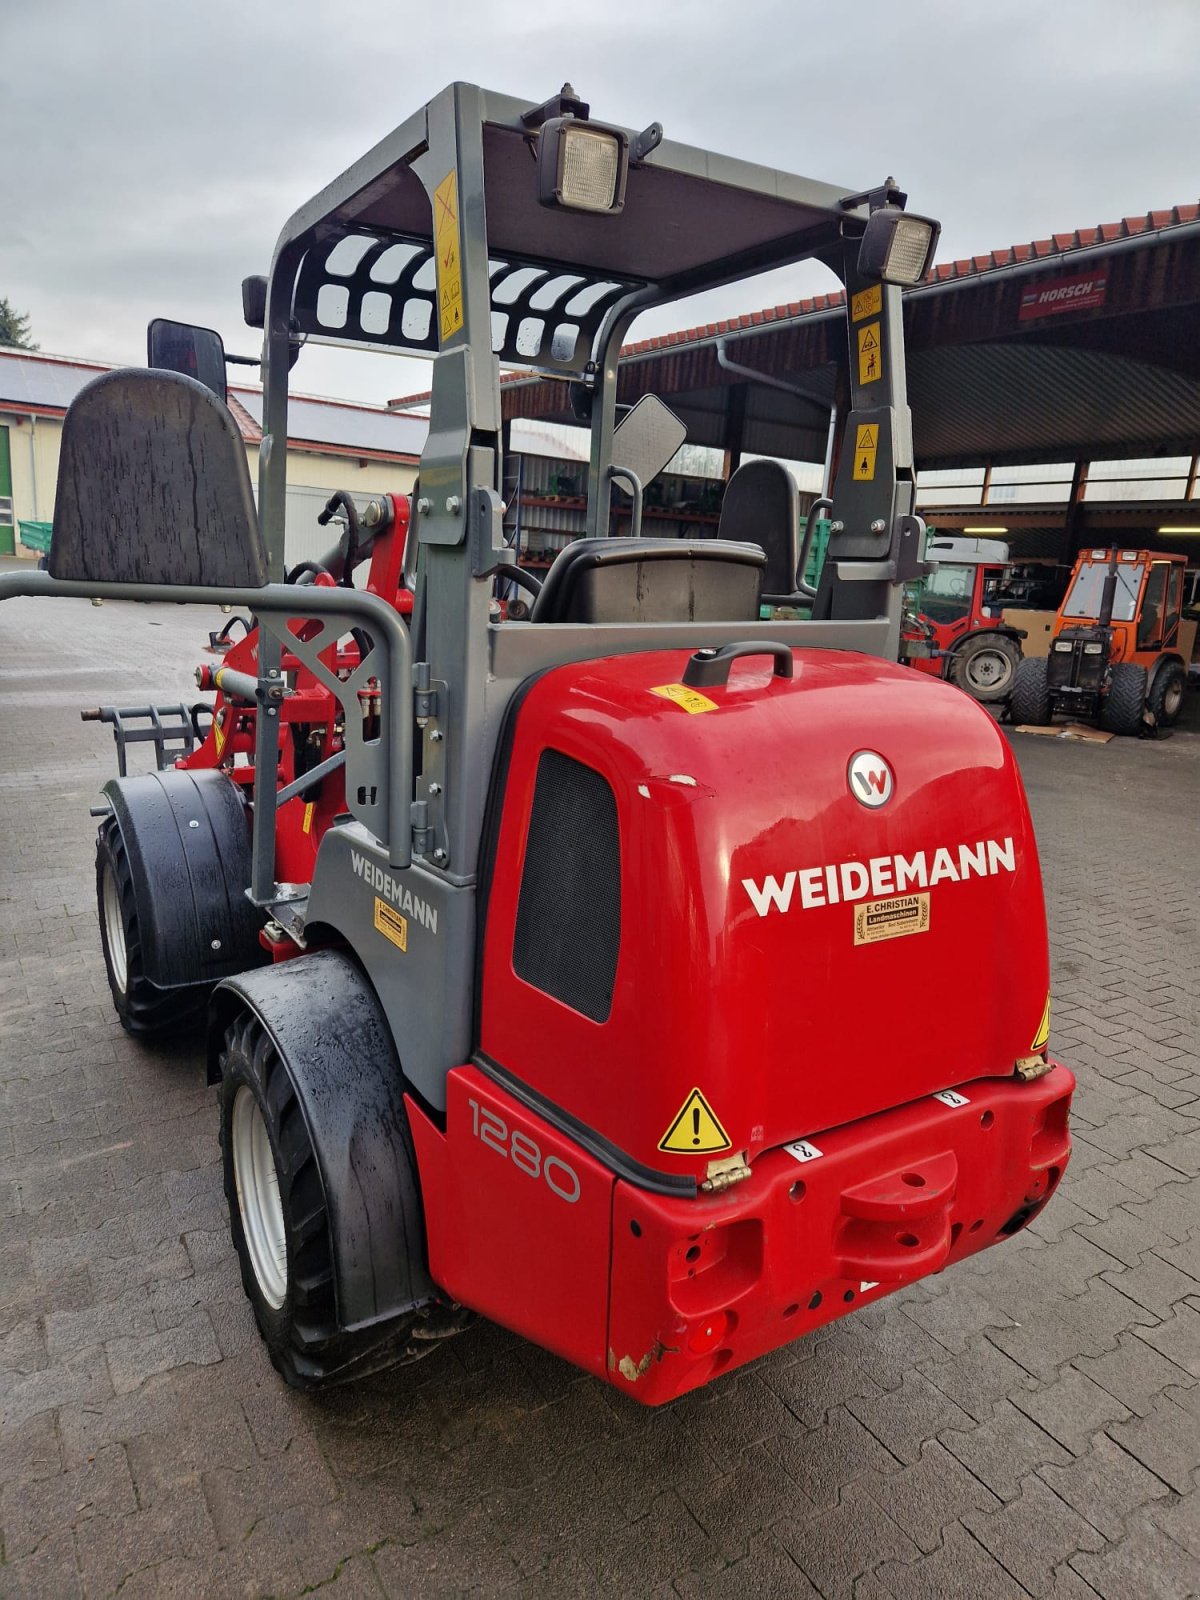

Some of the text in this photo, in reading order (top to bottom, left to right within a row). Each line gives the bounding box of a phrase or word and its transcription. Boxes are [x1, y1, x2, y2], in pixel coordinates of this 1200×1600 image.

[1039, 281, 1093, 303] HORSCH
[351, 848, 438, 935] WEIDEMANN
[741, 837, 1016, 917] WEIDEMANN
[868, 909, 917, 924] Landmaschinen
[874, 896, 919, 912] CHRISTIAN
[468, 1098, 580, 1203] 1280
